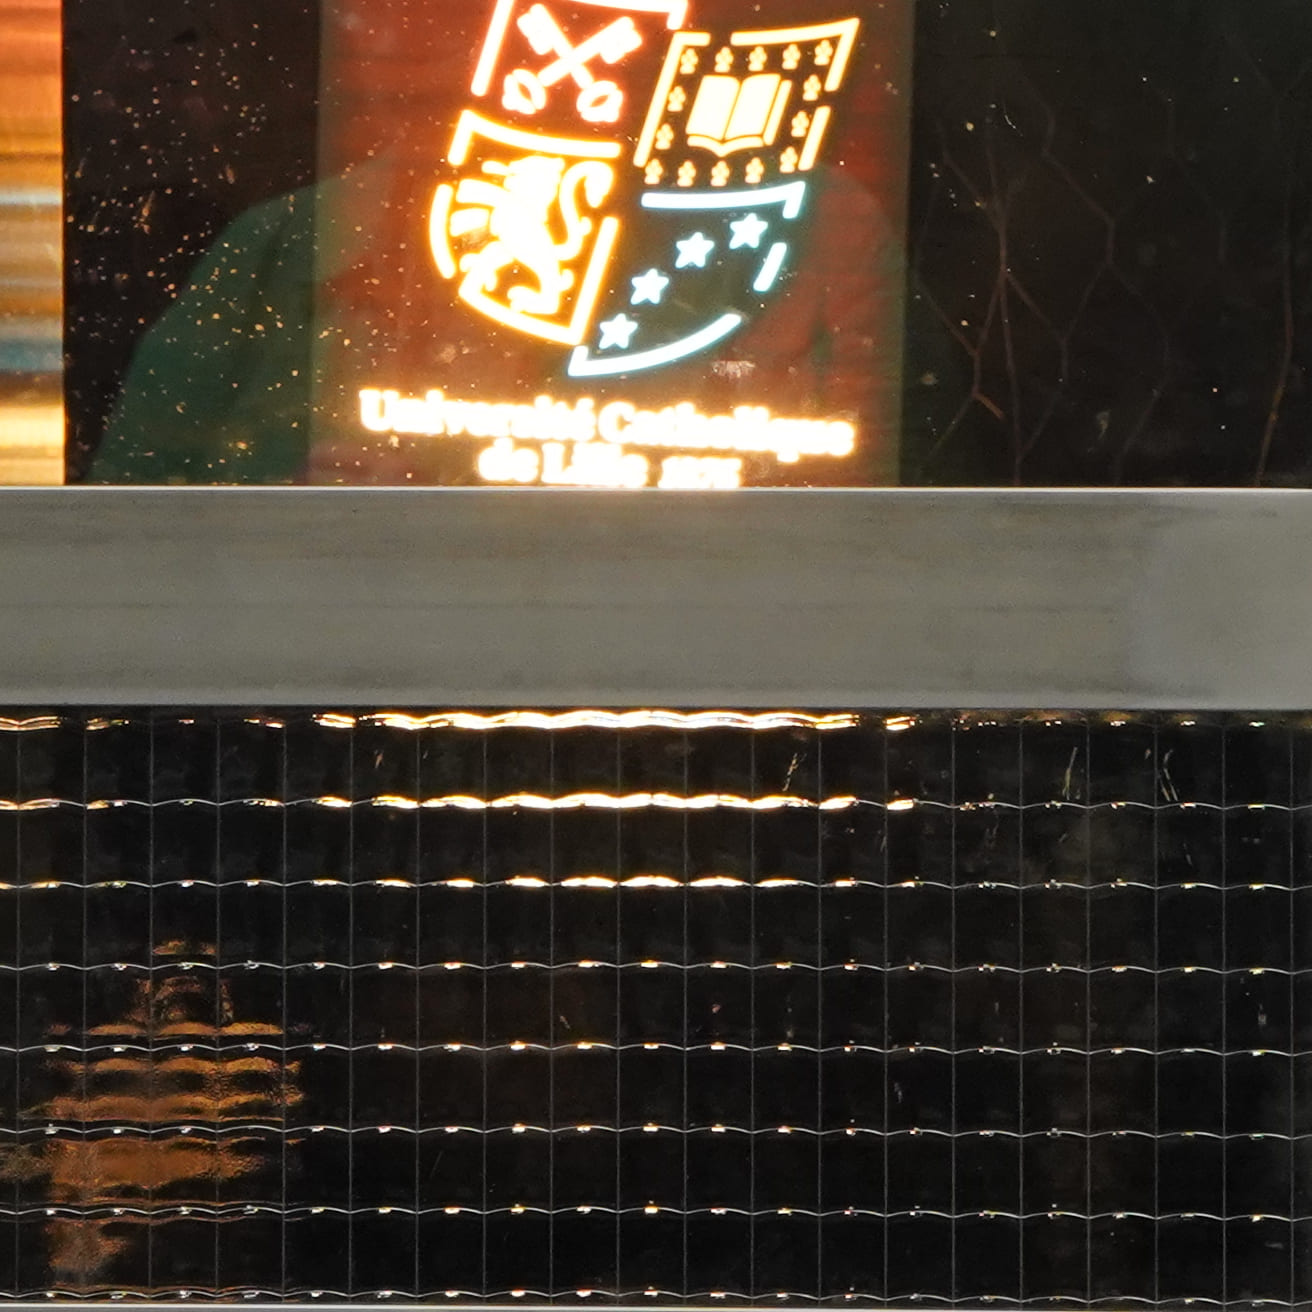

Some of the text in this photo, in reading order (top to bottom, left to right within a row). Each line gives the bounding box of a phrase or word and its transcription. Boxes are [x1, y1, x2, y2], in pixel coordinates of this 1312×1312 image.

[359, 390, 854, 463] Université Catholique
[478, 436, 539, 482] de
[541, 440, 649, 487] Lille
